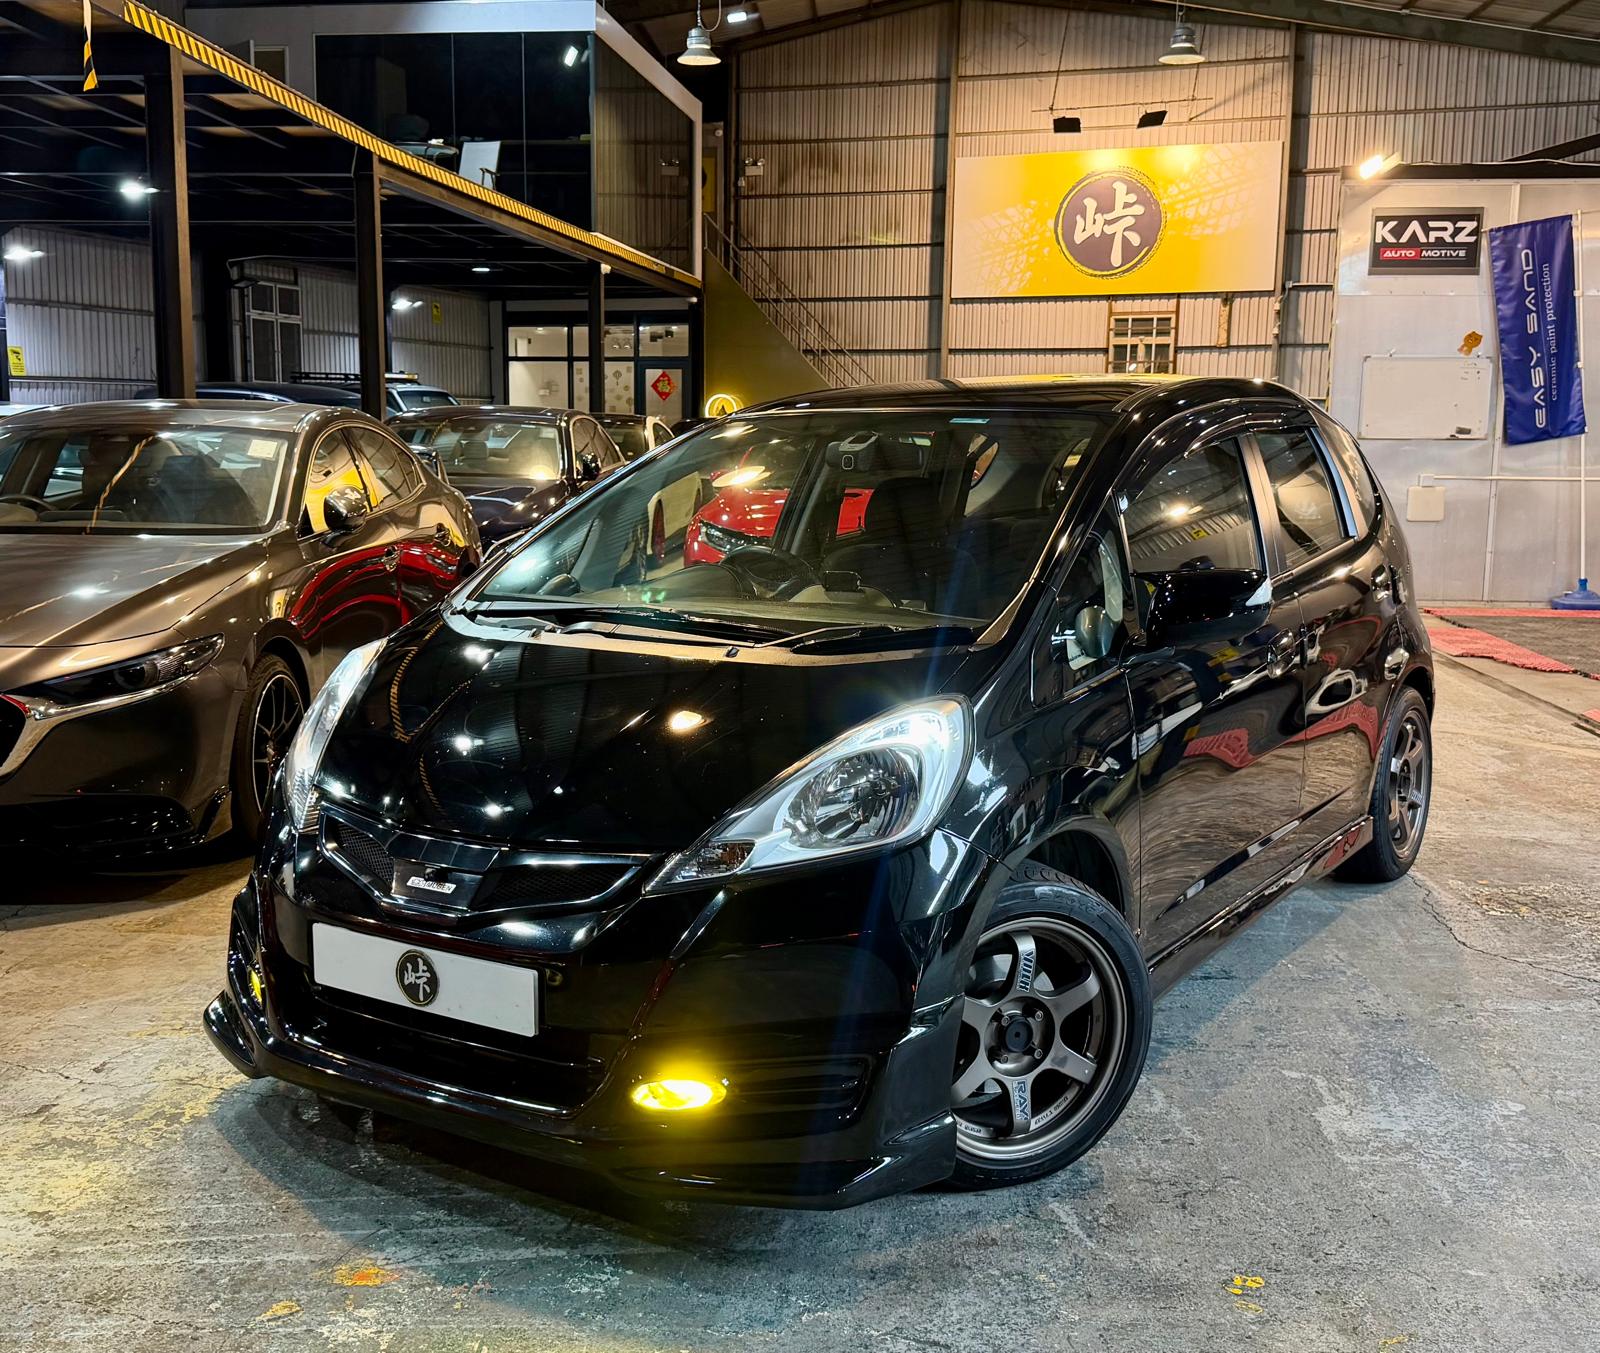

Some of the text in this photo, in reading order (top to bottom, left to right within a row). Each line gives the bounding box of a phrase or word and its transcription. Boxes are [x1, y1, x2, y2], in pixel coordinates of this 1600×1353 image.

[1073, 181, 1144, 267] 峠
[1375, 220, 1478, 243] KARZ
[1521, 249, 1546, 428] EASY SAND
[1541, 263, 1558, 401] ceramic paint protection
[404, 957, 431, 1001] 峠
